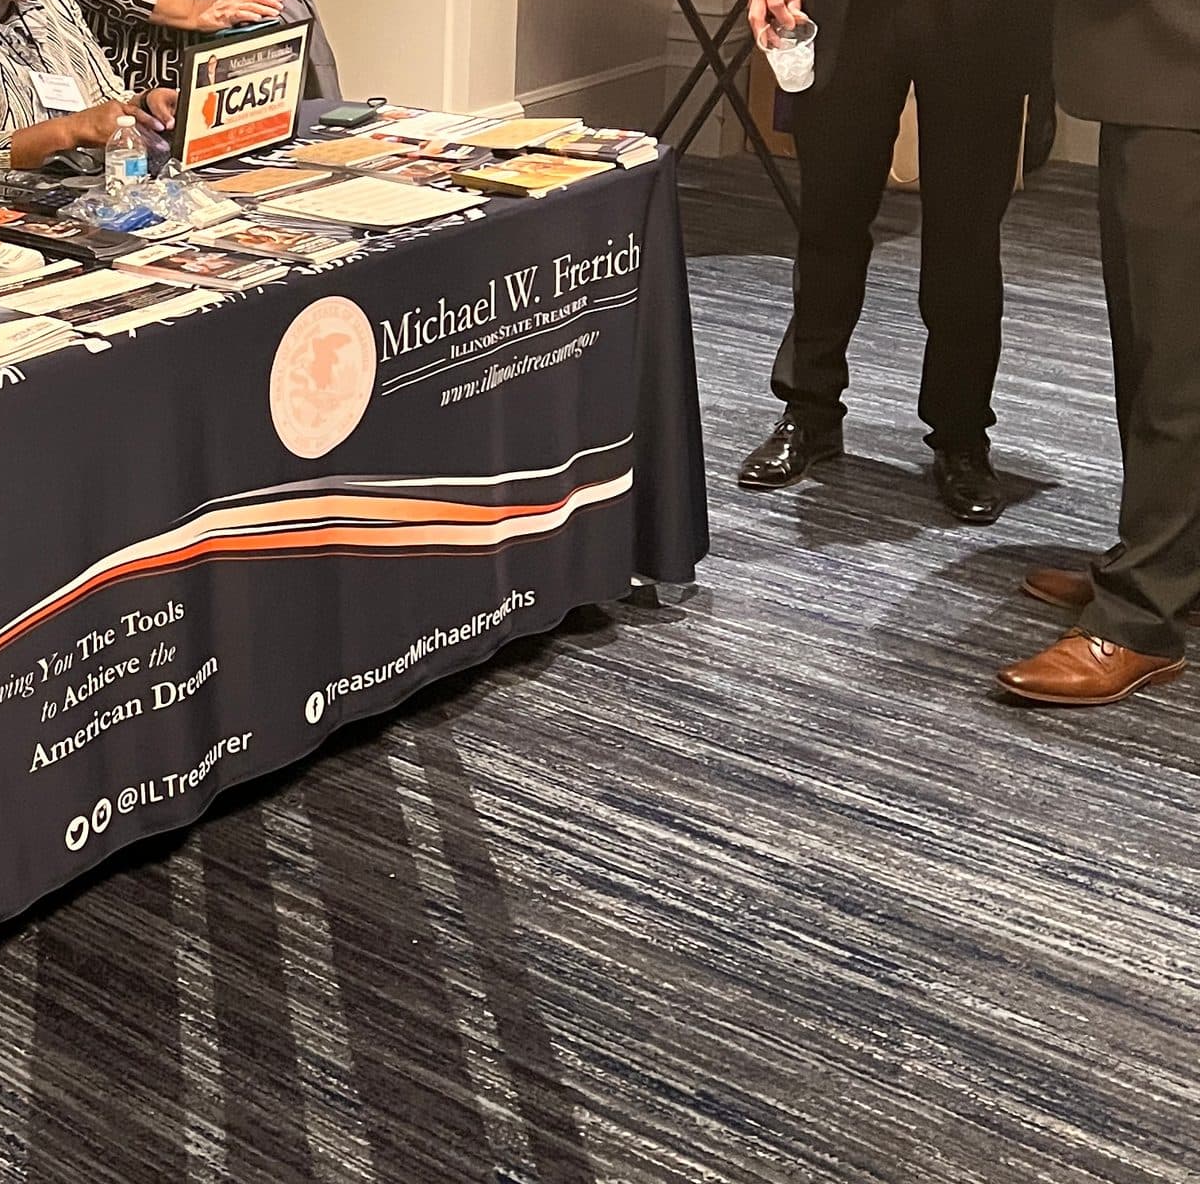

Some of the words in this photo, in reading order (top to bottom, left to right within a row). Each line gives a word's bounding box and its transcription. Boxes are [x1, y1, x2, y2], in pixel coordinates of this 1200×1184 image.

[379, 280, 499, 364] Michael
[504, 265, 541, 311] W.
[553, 233, 640, 297] Frerich
[450, 330, 498, 360] ILLINOIS
[499, 319, 532, 340] STATE
[533, 296, 588, 328] TREASURER
[36, 652, 74, 683] You
[76, 627, 116, 661] The
[120, 599, 186, 638] Tools
[41, 698, 58, 723] to
[62, 655, 141, 712] Achieve
[149, 641, 178, 668] the
[29, 697, 143, 773] American
[152, 655, 219, 711] Dream
[116, 731, 253, 814] @ILTreasurer
